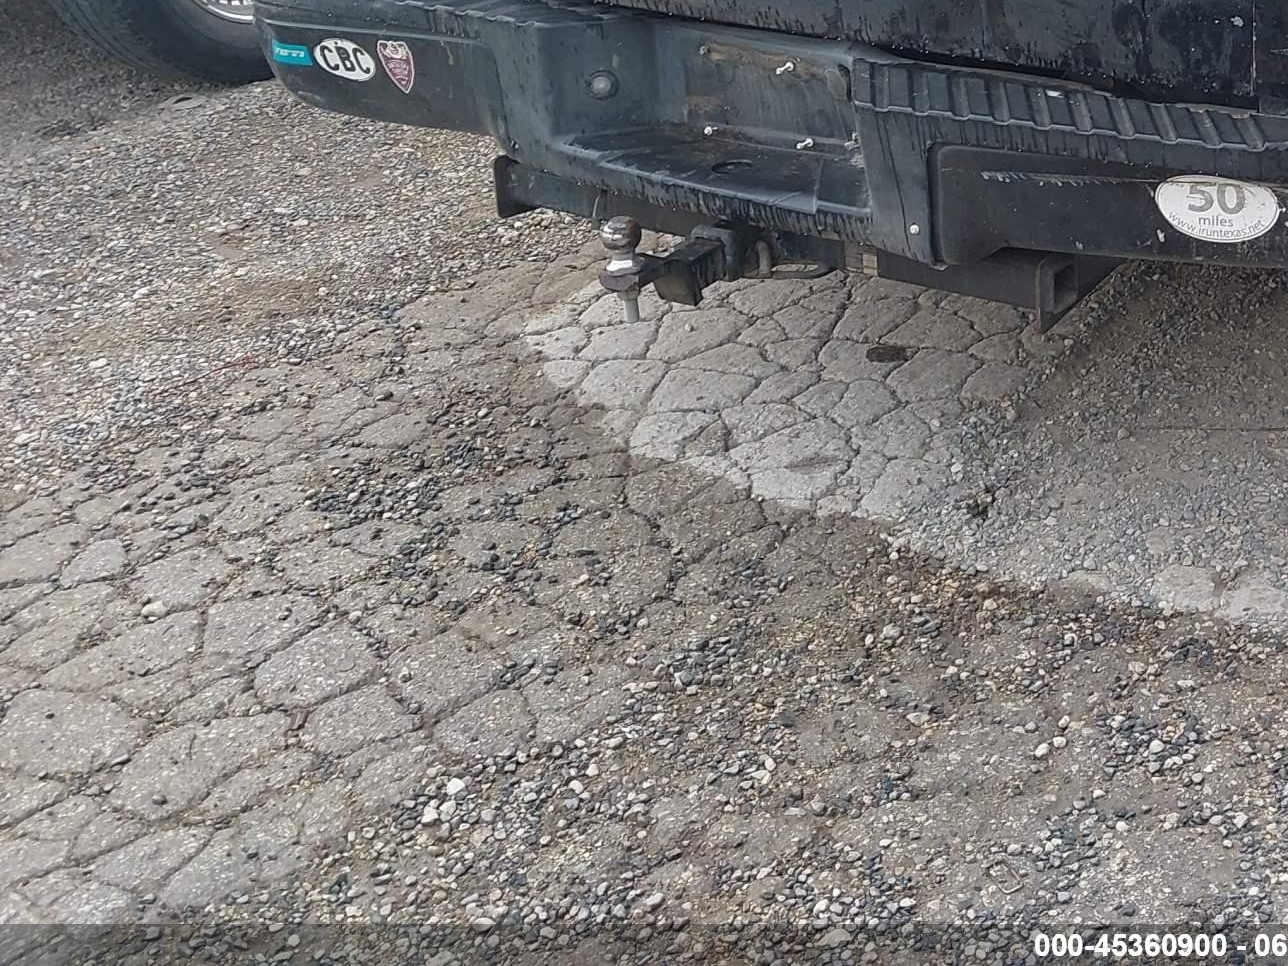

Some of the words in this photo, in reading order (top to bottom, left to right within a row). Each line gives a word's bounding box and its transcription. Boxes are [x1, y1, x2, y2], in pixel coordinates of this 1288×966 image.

[319, 45, 371, 74] CBC
[1186, 183, 1247, 214] 50
[1168, 211, 1266, 238] www.iruntexas.net
[1198, 216, 1234, 228] miles
